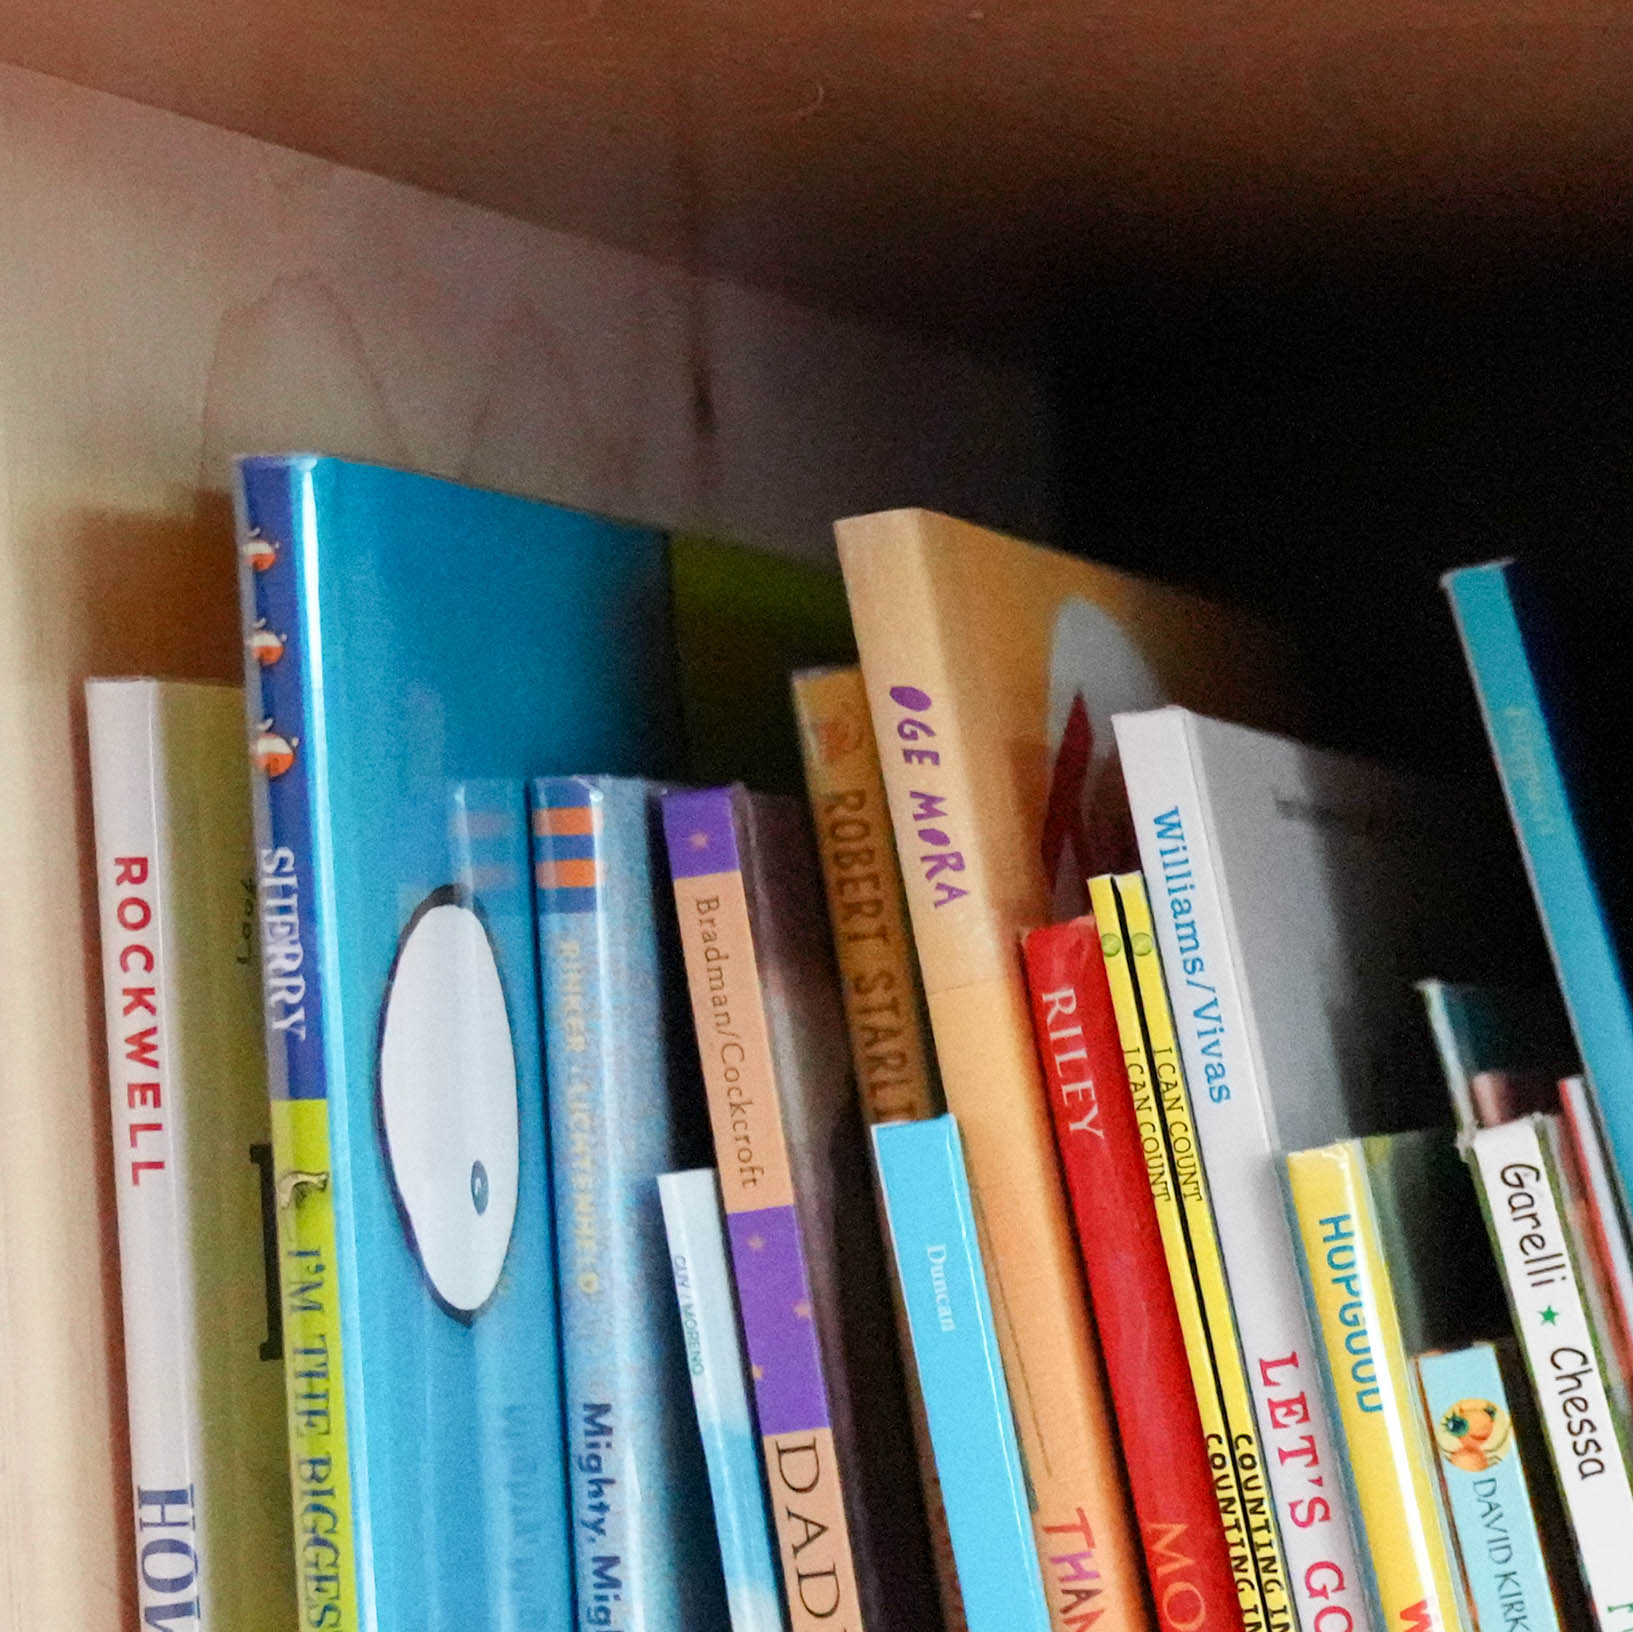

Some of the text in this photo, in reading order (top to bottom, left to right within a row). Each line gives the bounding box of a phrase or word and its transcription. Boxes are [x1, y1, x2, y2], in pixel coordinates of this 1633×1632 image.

[886, 680, 973, 911] OGE MORA
[110, 855, 168, 1187] ROCKWELL
[255, 845, 307, 1044] SHERRY
[1147, 806, 1239, 1105] Williams/Vivas
[690, 894, 767, 1191] Bradman/Cockcroft
[1036, 982, 1106, 1146] RILEY
[283, 1244, 328, 1314] I'M
[1496, 1156, 1616, 1482] Garelli Chessa
[287, 1331, 334, 1437] THE
[573, 1401, 619, 1546] Mighty,
[1257, 1349, 1333, 1531] LET'S
[1230, 1431, 1283, 1597] COUNTING
[1470, 1476, 1515, 1568] DAVID
